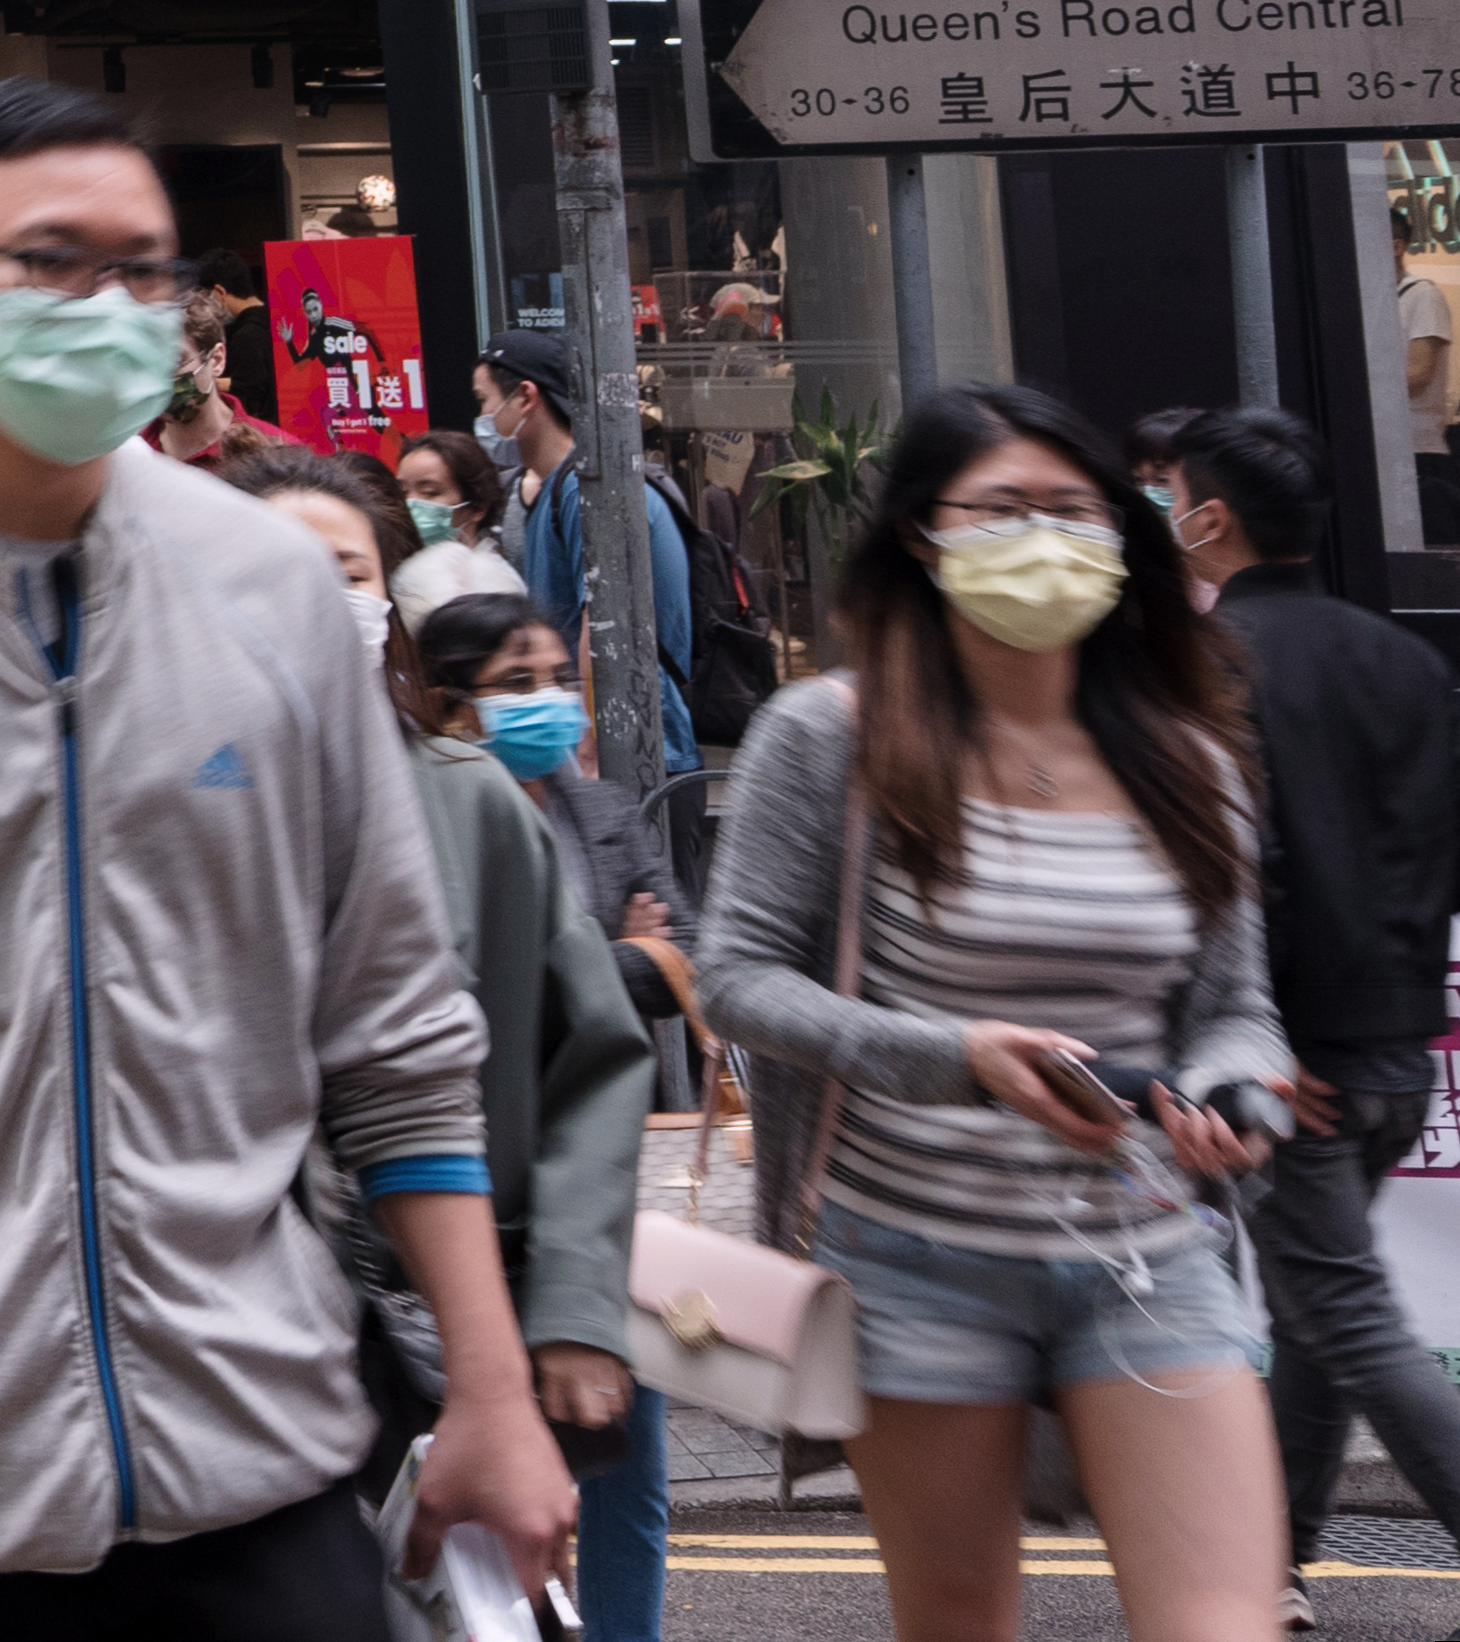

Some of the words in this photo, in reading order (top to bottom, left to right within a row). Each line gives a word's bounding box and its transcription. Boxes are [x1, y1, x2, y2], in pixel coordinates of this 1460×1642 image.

[937, 61, 1324, 125] 皇后大道中
[1346, 68, 1460, 101] 36-78
[789, 84, 911, 120] 30-36
[517, 318, 533, 328] TO
[322, 332, 368, 355] sale
[367, 414, 391, 427] free
